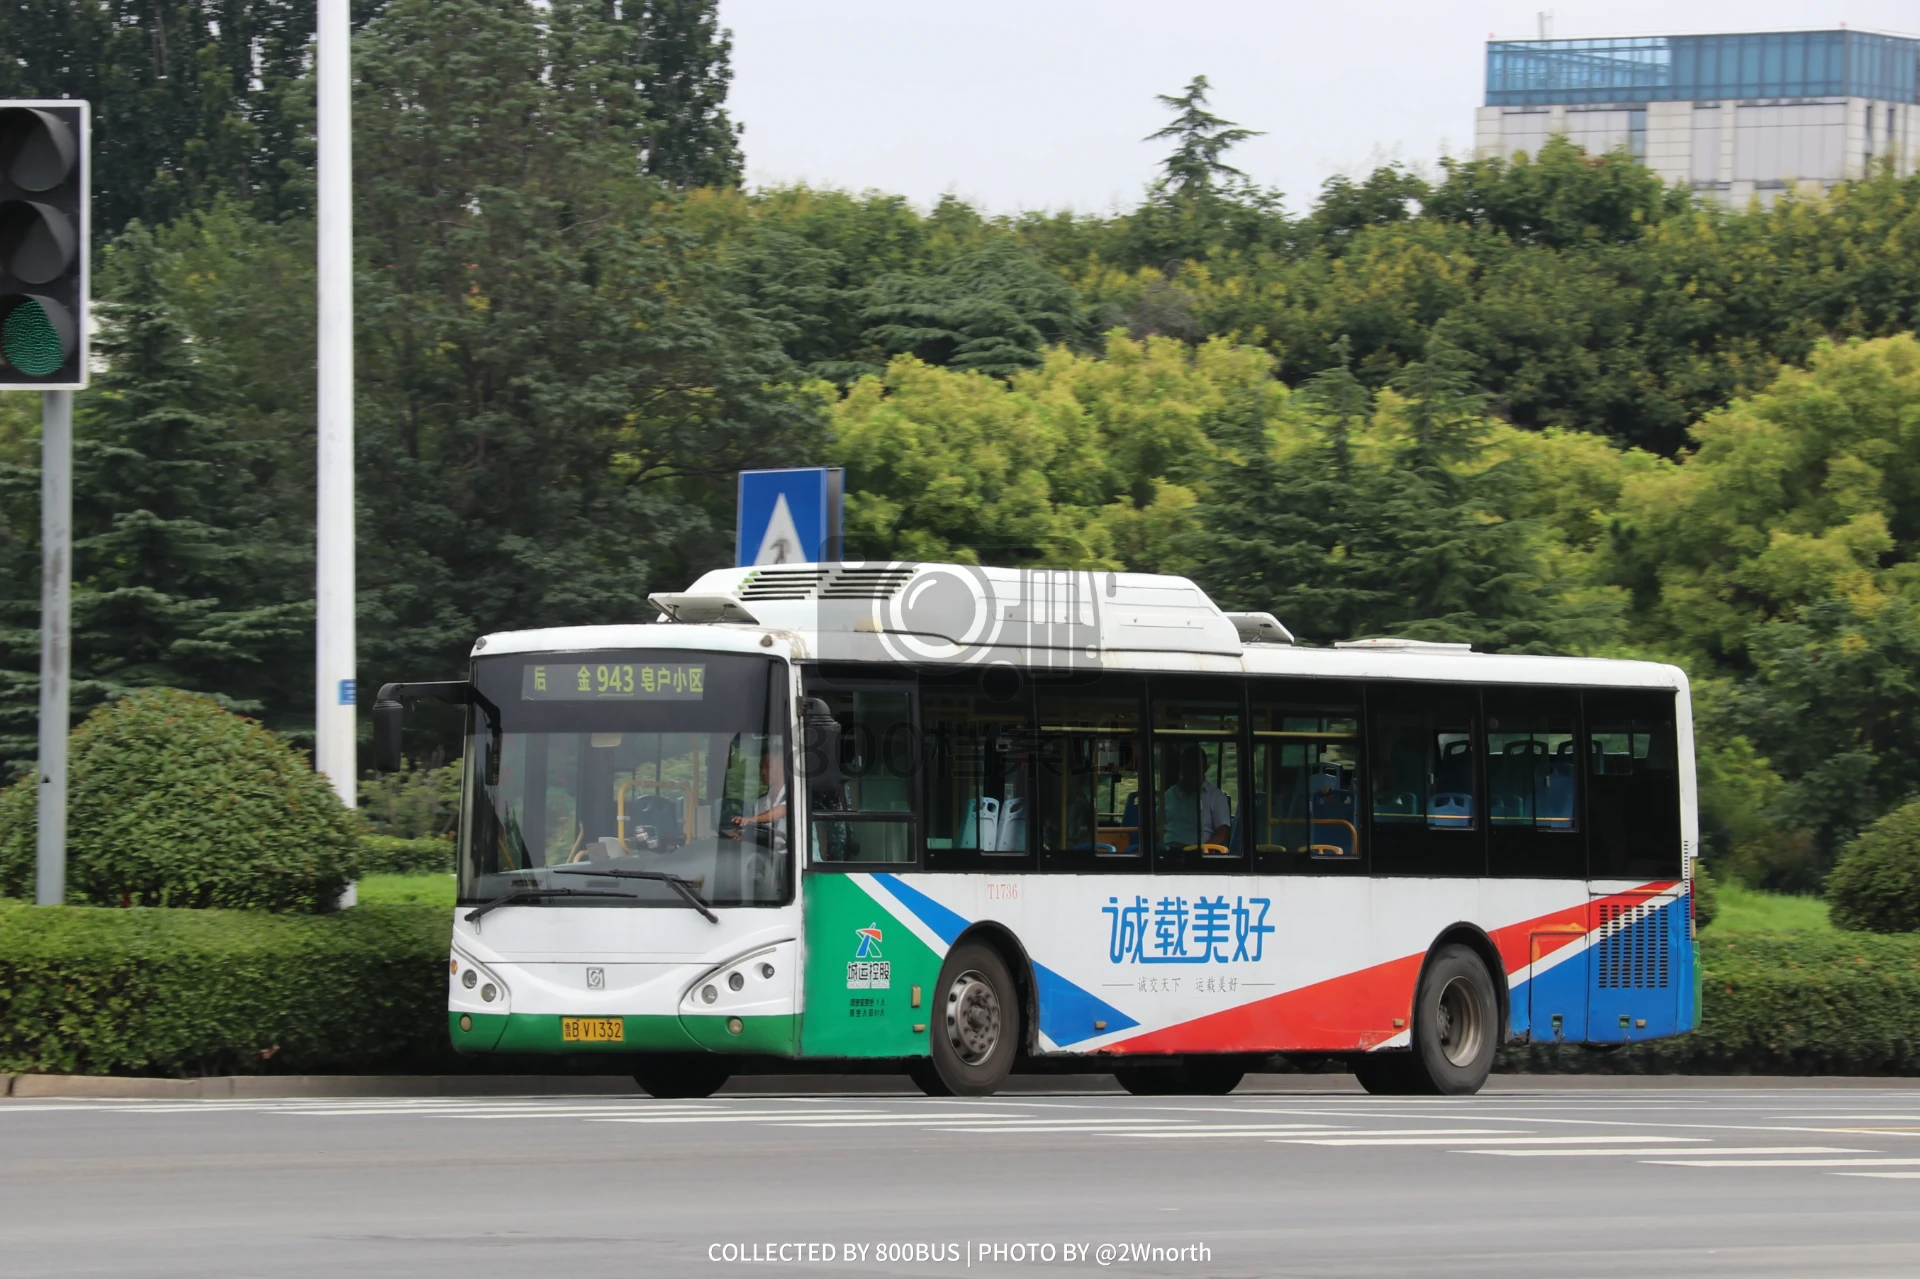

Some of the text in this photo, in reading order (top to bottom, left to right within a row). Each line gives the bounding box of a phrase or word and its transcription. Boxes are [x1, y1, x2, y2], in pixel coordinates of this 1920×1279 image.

[597, 665, 634, 692] 943
[641, 667, 704, 693] 皂户小区
[987, 884, 1018, 899] T1736
[1102, 895, 1275, 964] 诚载美好
[847, 962, 890, 981] 城运控股
[1138, 976, 1238, 993] 诚交天下 运载美好
